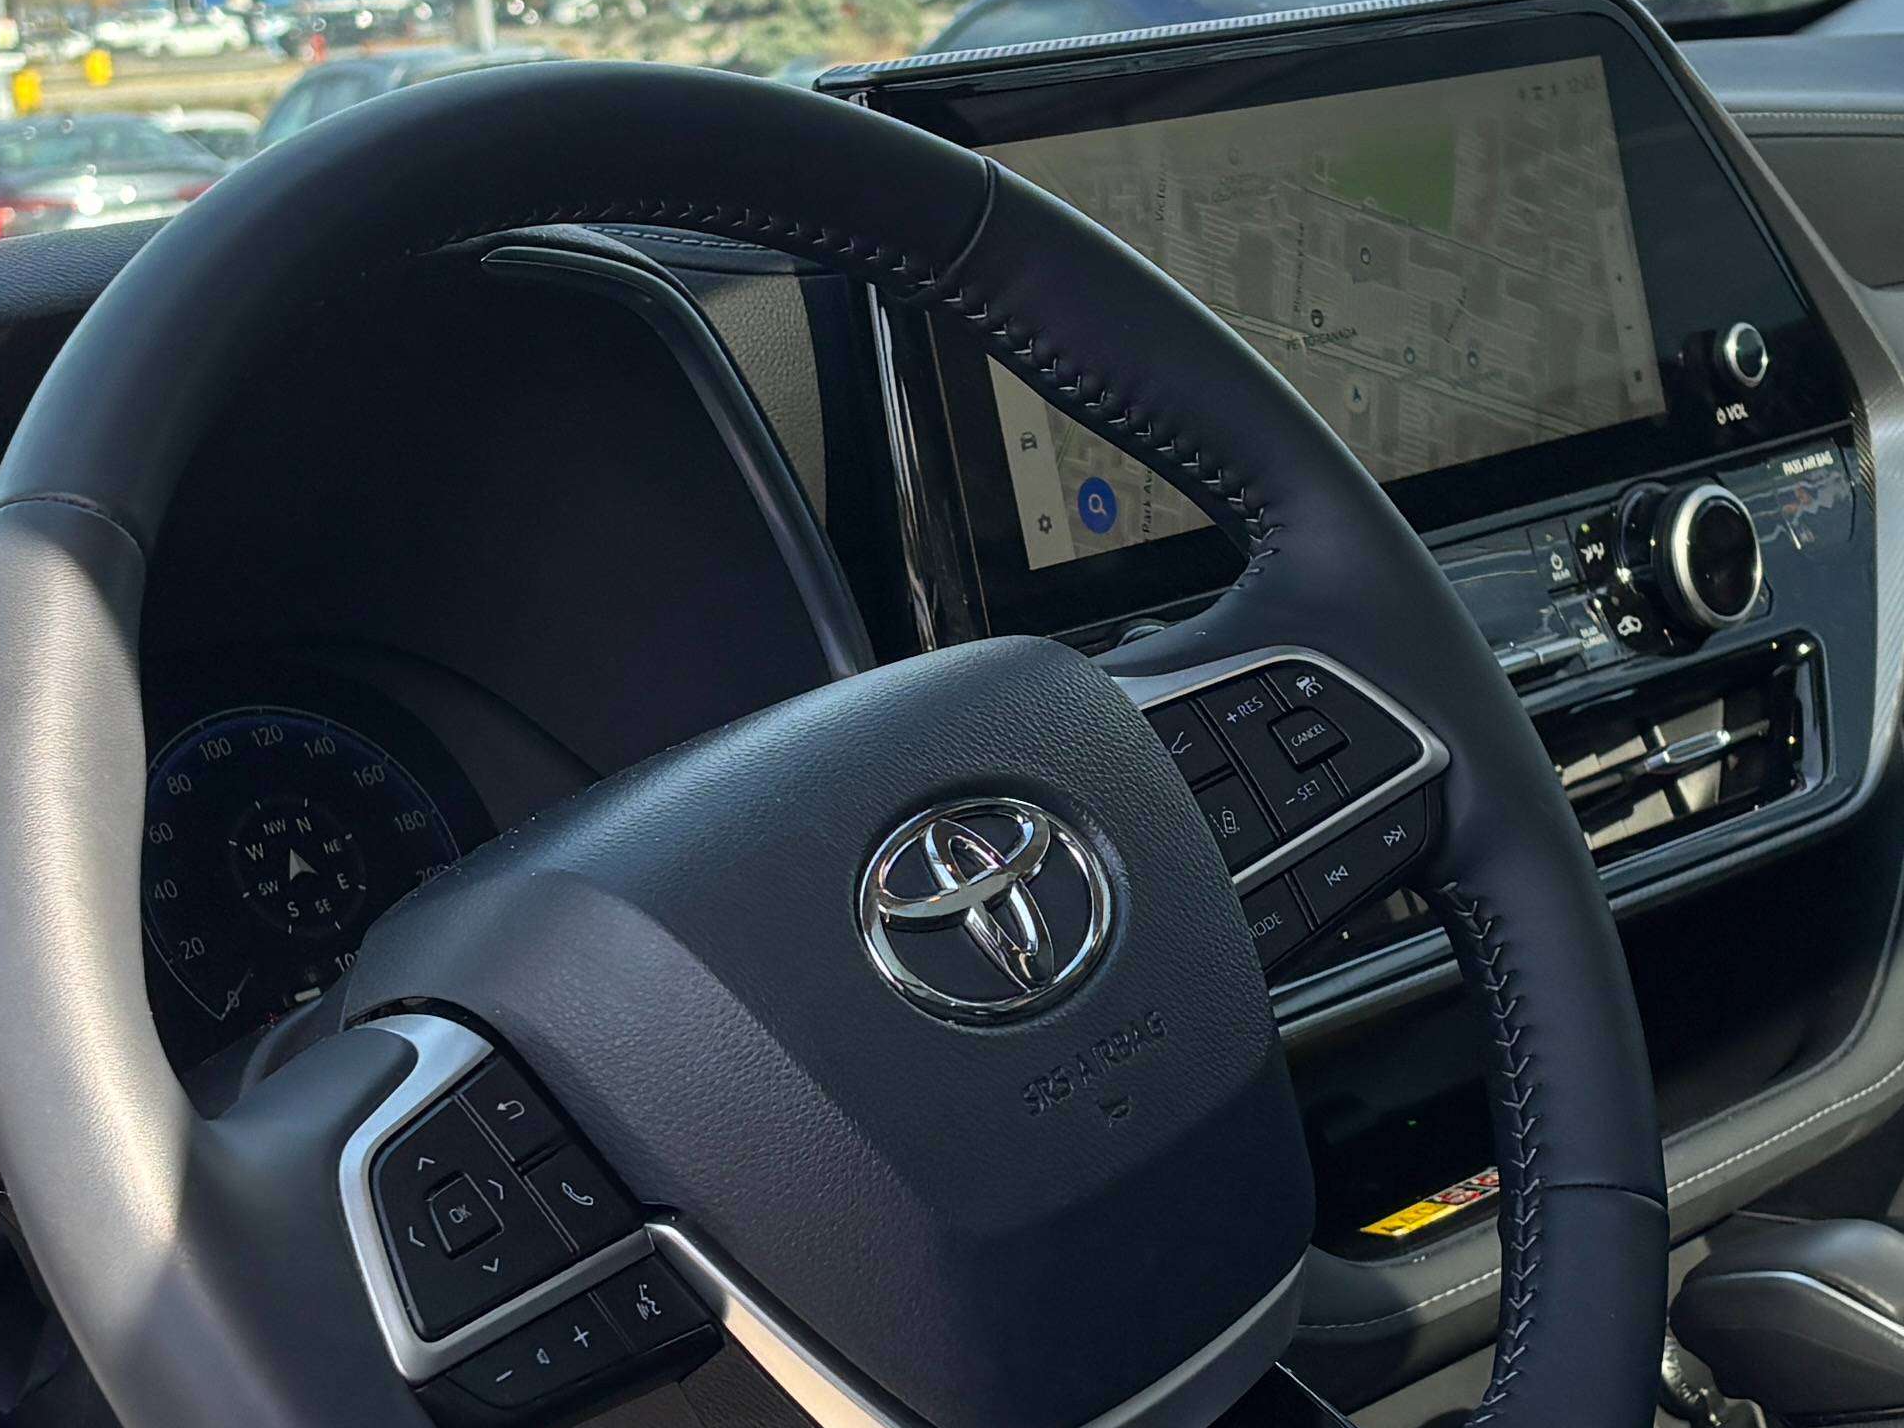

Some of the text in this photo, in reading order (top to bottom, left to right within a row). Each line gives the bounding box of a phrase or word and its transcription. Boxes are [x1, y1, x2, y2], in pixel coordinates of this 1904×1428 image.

[1725, 402, 1749, 421] VOL
[251, 723, 284, 748] 120
[1290, 722, 1328, 747] CANCEL
[199, 736, 233, 762] 100
[304, 735, 337, 760] 140
[166, 773, 192, 795] 80
[353, 764, 386, 788] 160
[262, 819, 287, 835] NW
[296, 815, 313, 834] N
[394, 809, 427, 833] 180
[149, 822, 174, 845] 60
[245, 842, 265, 861] W
[153, 878, 179, 901] 40
[336, 872, 350, 891] E
[287, 900, 300, 918] S
[179, 936, 206, 961] 20
[1022, 1010, 1168, 1117] SRS AIRBAG
[448, 1203, 473, 1224] OK
